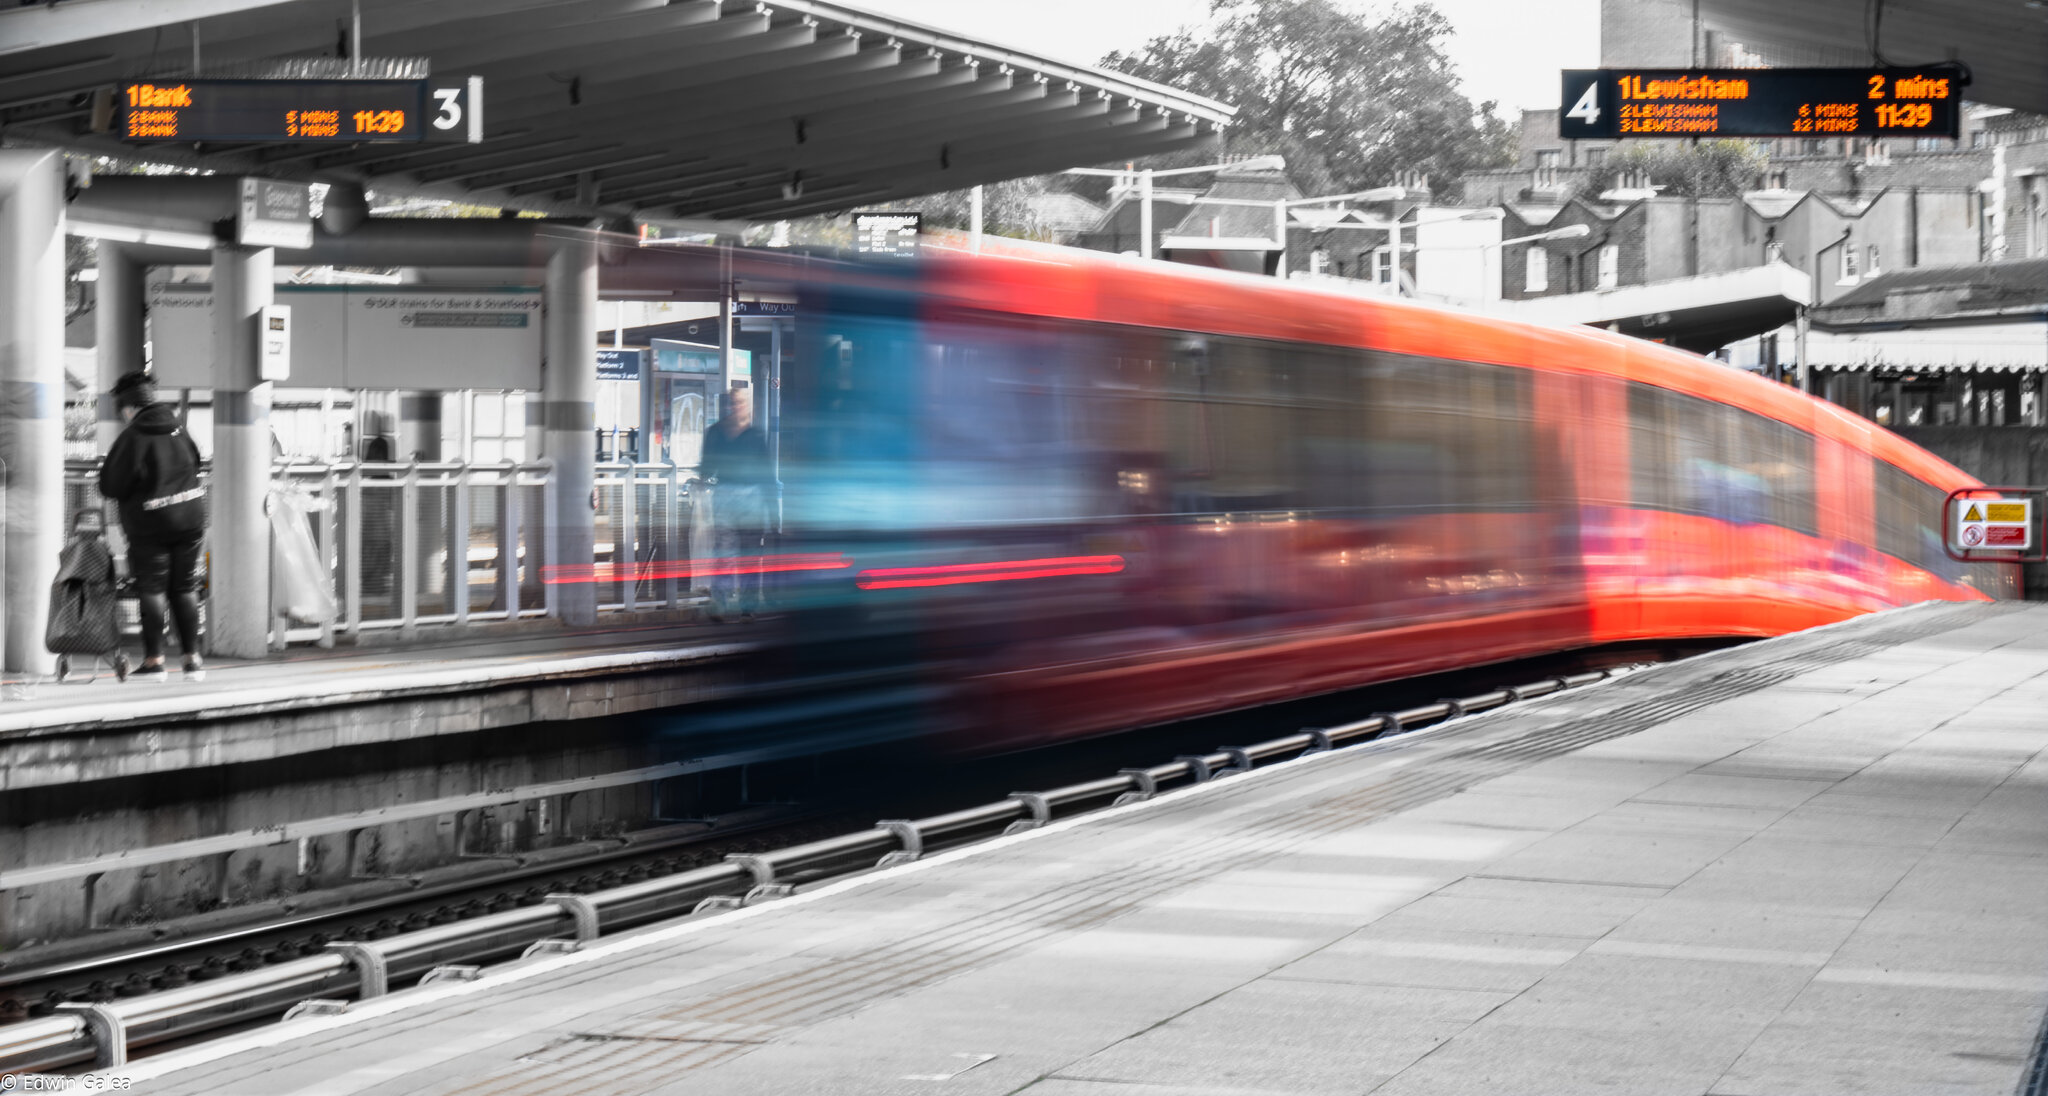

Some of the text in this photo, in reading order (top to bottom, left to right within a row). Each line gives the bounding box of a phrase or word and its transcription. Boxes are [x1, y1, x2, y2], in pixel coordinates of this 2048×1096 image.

[1868, 74, 1886, 100] 2
[1894, 74, 1949, 99] mins
[432, 88, 462, 130] 3
[1565, 80, 1601, 125] 4
[300, 110, 340, 124] MINS
[1815, 103, 1859, 118] MINS
[1874, 103, 1933, 128] 11:39
[300, 123, 340, 137] MINS
[1792, 118, 1813, 132] 12
[1815, 118, 1859, 132] MINS
[760, 303, 779, 314] Way
